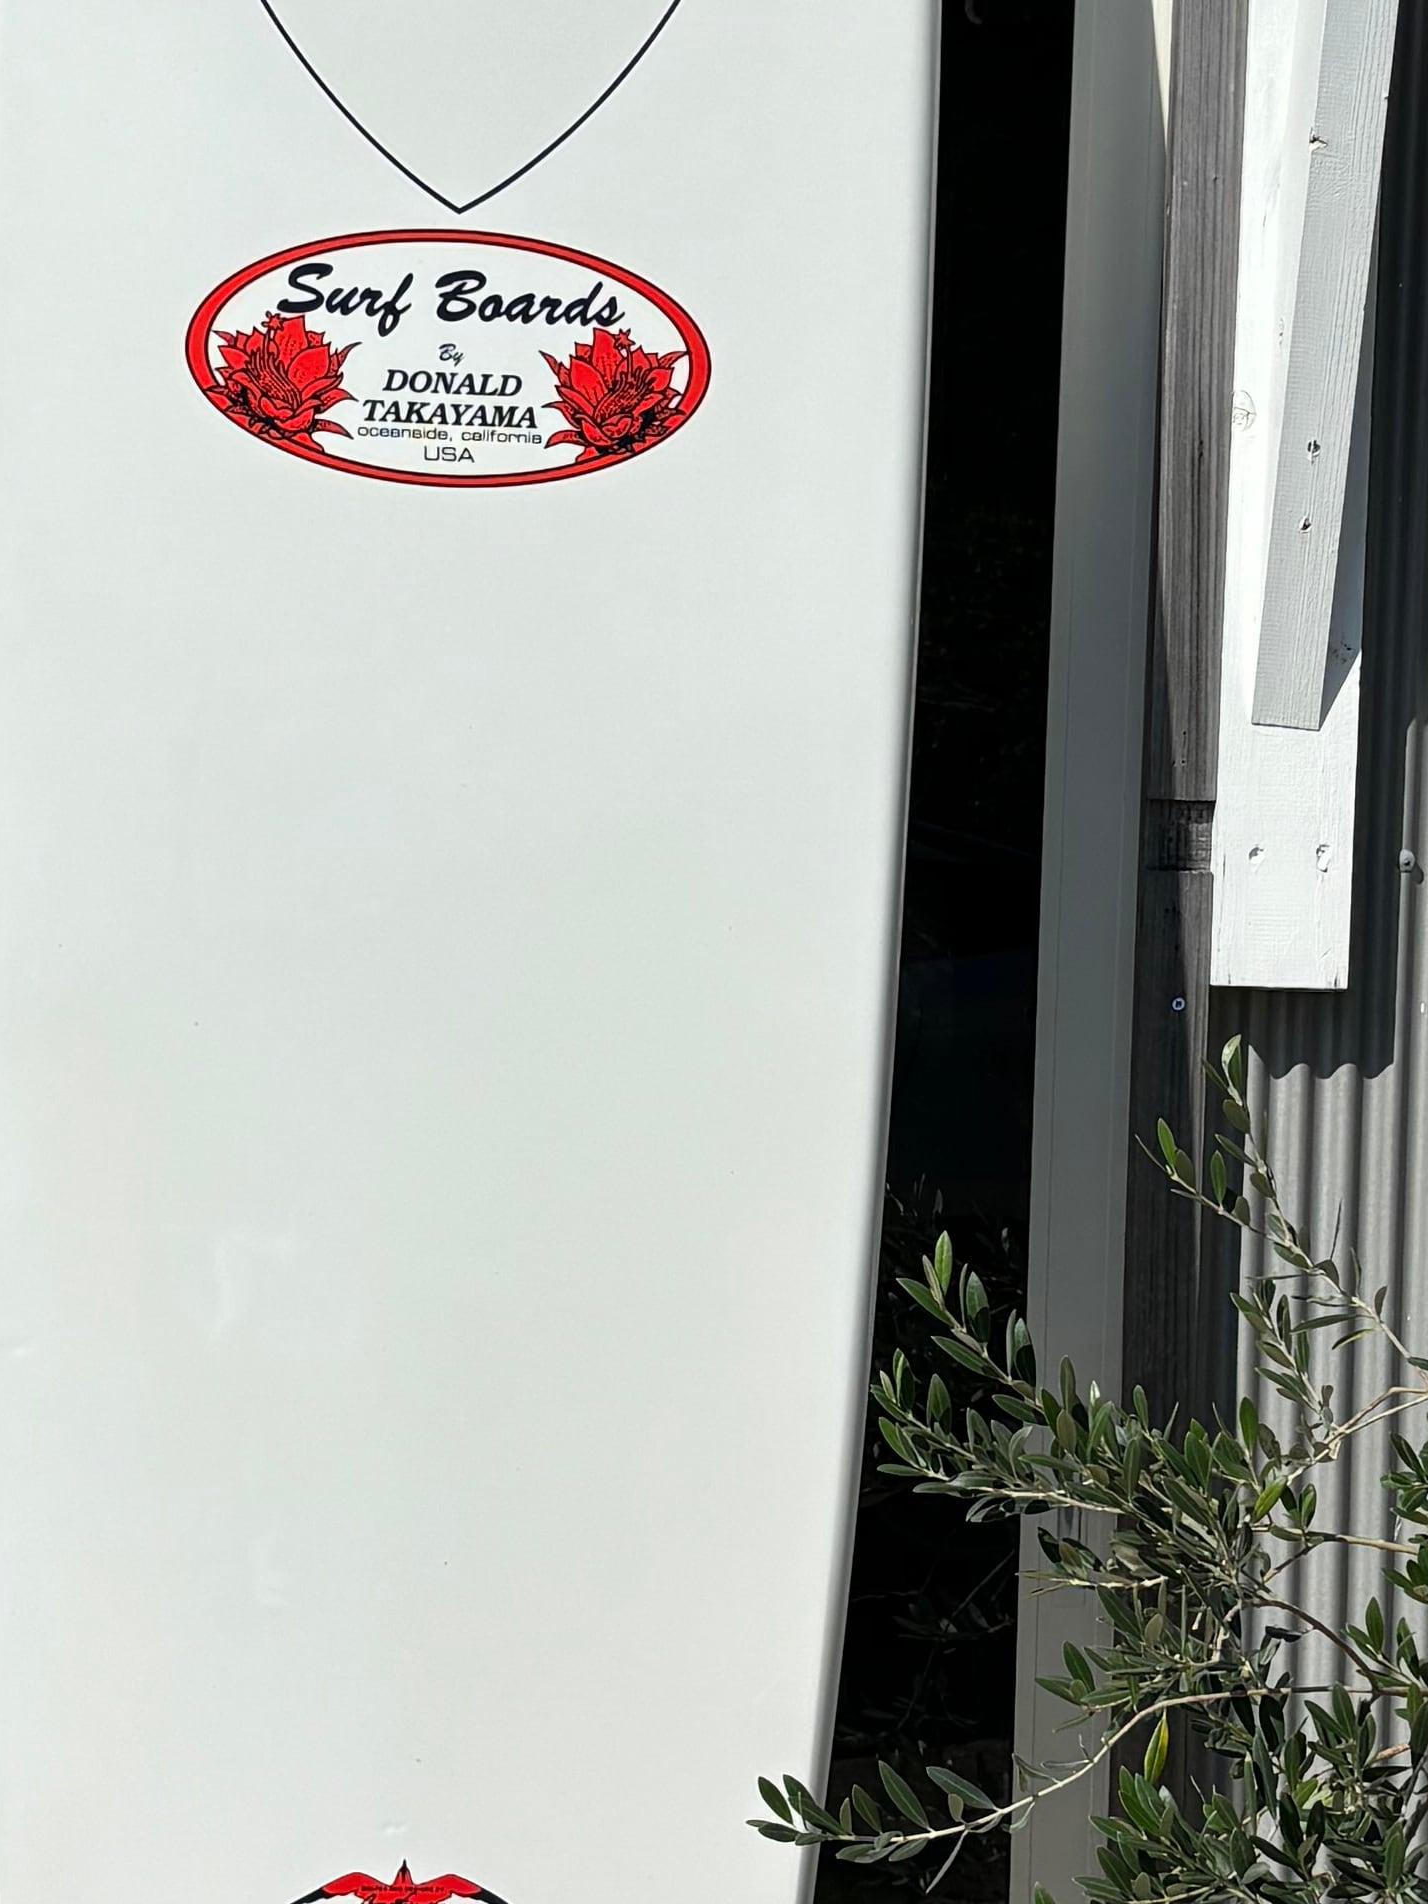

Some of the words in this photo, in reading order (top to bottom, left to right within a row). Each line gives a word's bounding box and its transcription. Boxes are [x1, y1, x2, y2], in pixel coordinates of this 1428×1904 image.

[276, 263, 415, 336] Surf
[434, 270, 625, 327] Boards
[438, 343, 464, 364] By
[382, 369, 522, 396] DONALD
[362, 400, 537, 428] TAKAYAMA
[357, 427, 453, 443] oceanside,
[461, 430, 542, 445] california
[423, 446, 475, 463] USA
